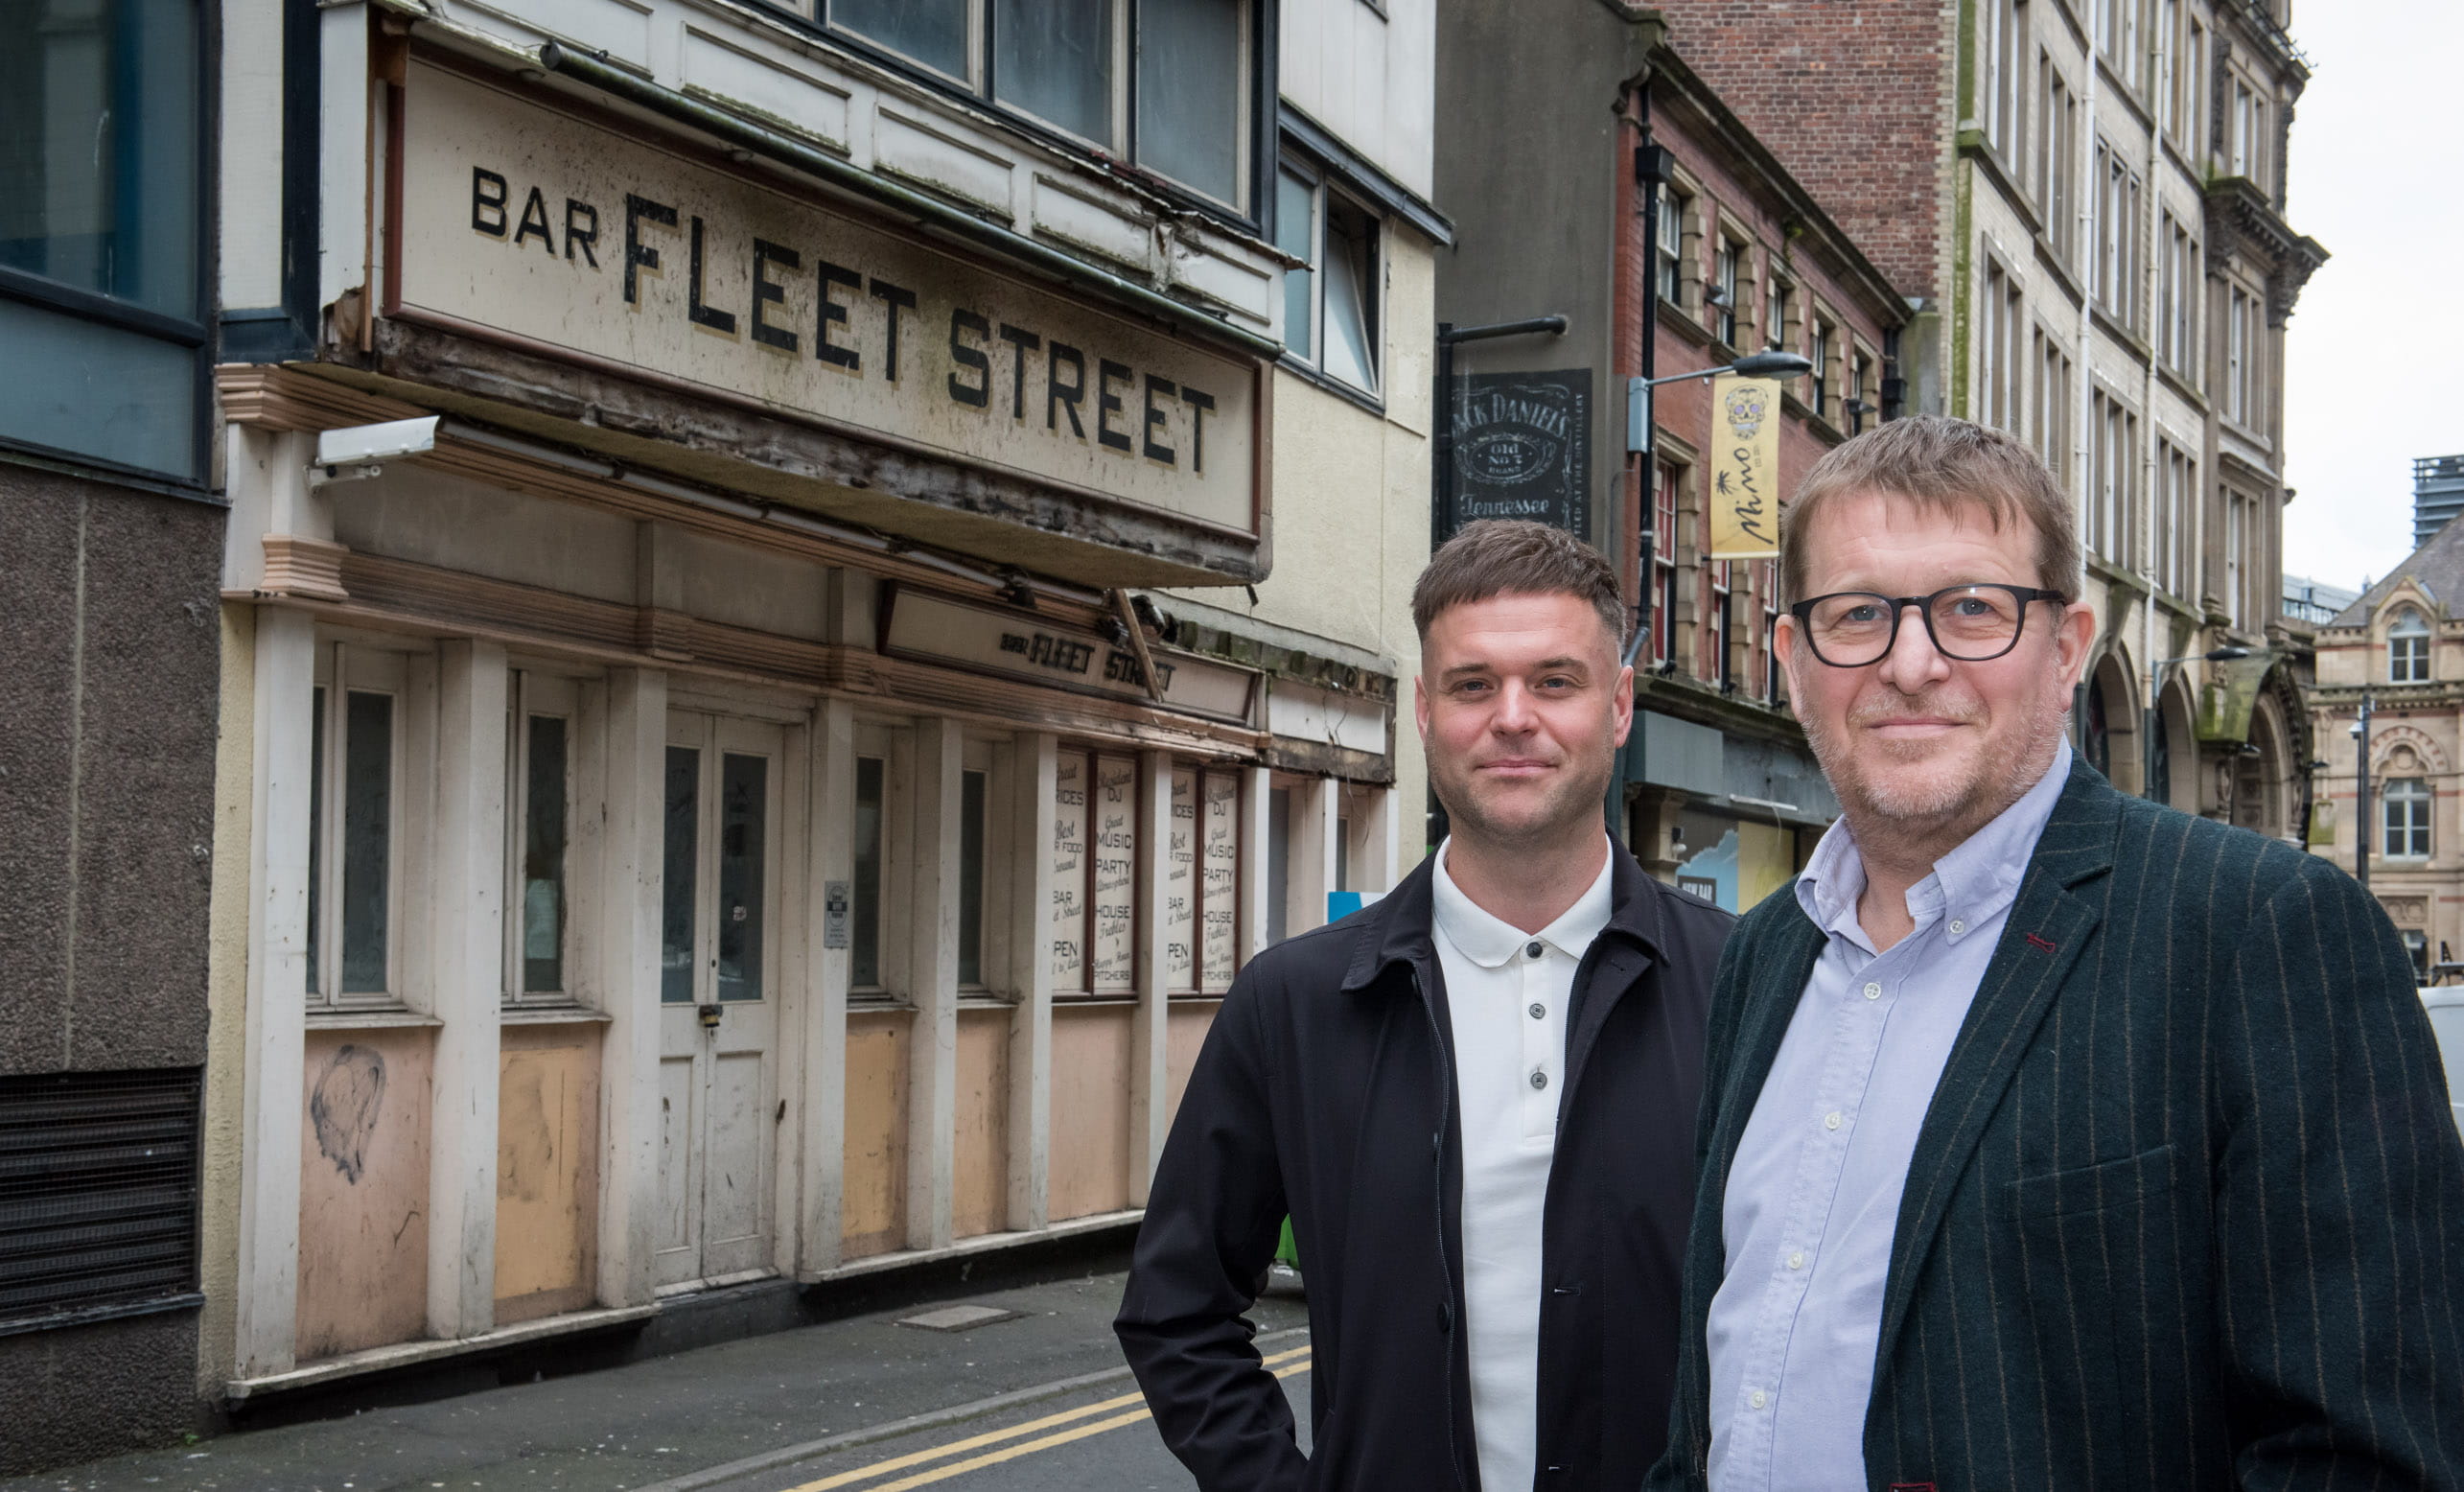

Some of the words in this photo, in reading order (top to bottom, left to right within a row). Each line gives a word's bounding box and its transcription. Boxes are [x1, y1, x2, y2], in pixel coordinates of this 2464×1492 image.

[472, 165, 601, 269] BAR
[622, 192, 918, 385] FLEET
[947, 306, 1219, 479] STREET
[1453, 403, 1487, 439] ACK
[1459, 493, 1550, 517] Tennessee
[1000, 632, 1029, 655] BAR
[1029, 633, 1096, 675] FLEET
[1056, 789, 1084, 805] RICES
[1107, 786, 1123, 803] DJ
[1213, 802, 1225, 816] DJ
[1056, 819, 1075, 840] Best
[1104, 814, 1124, 834] Great
[1062, 841, 1083, 853] FOOD
[1096, 832, 1132, 850] MUSIC
[1204, 844, 1235, 859] MUSIC
[1096, 858, 1131, 875] PARTY
[1203, 867, 1234, 882] PARTY
[1053, 890, 1073, 905] BAR
[1095, 904, 1130, 920] HOUSE
[1203, 910, 1233, 923] HOUSE
[1054, 941, 1079, 958] PEN
[1168, 943, 1189, 959] PEN
